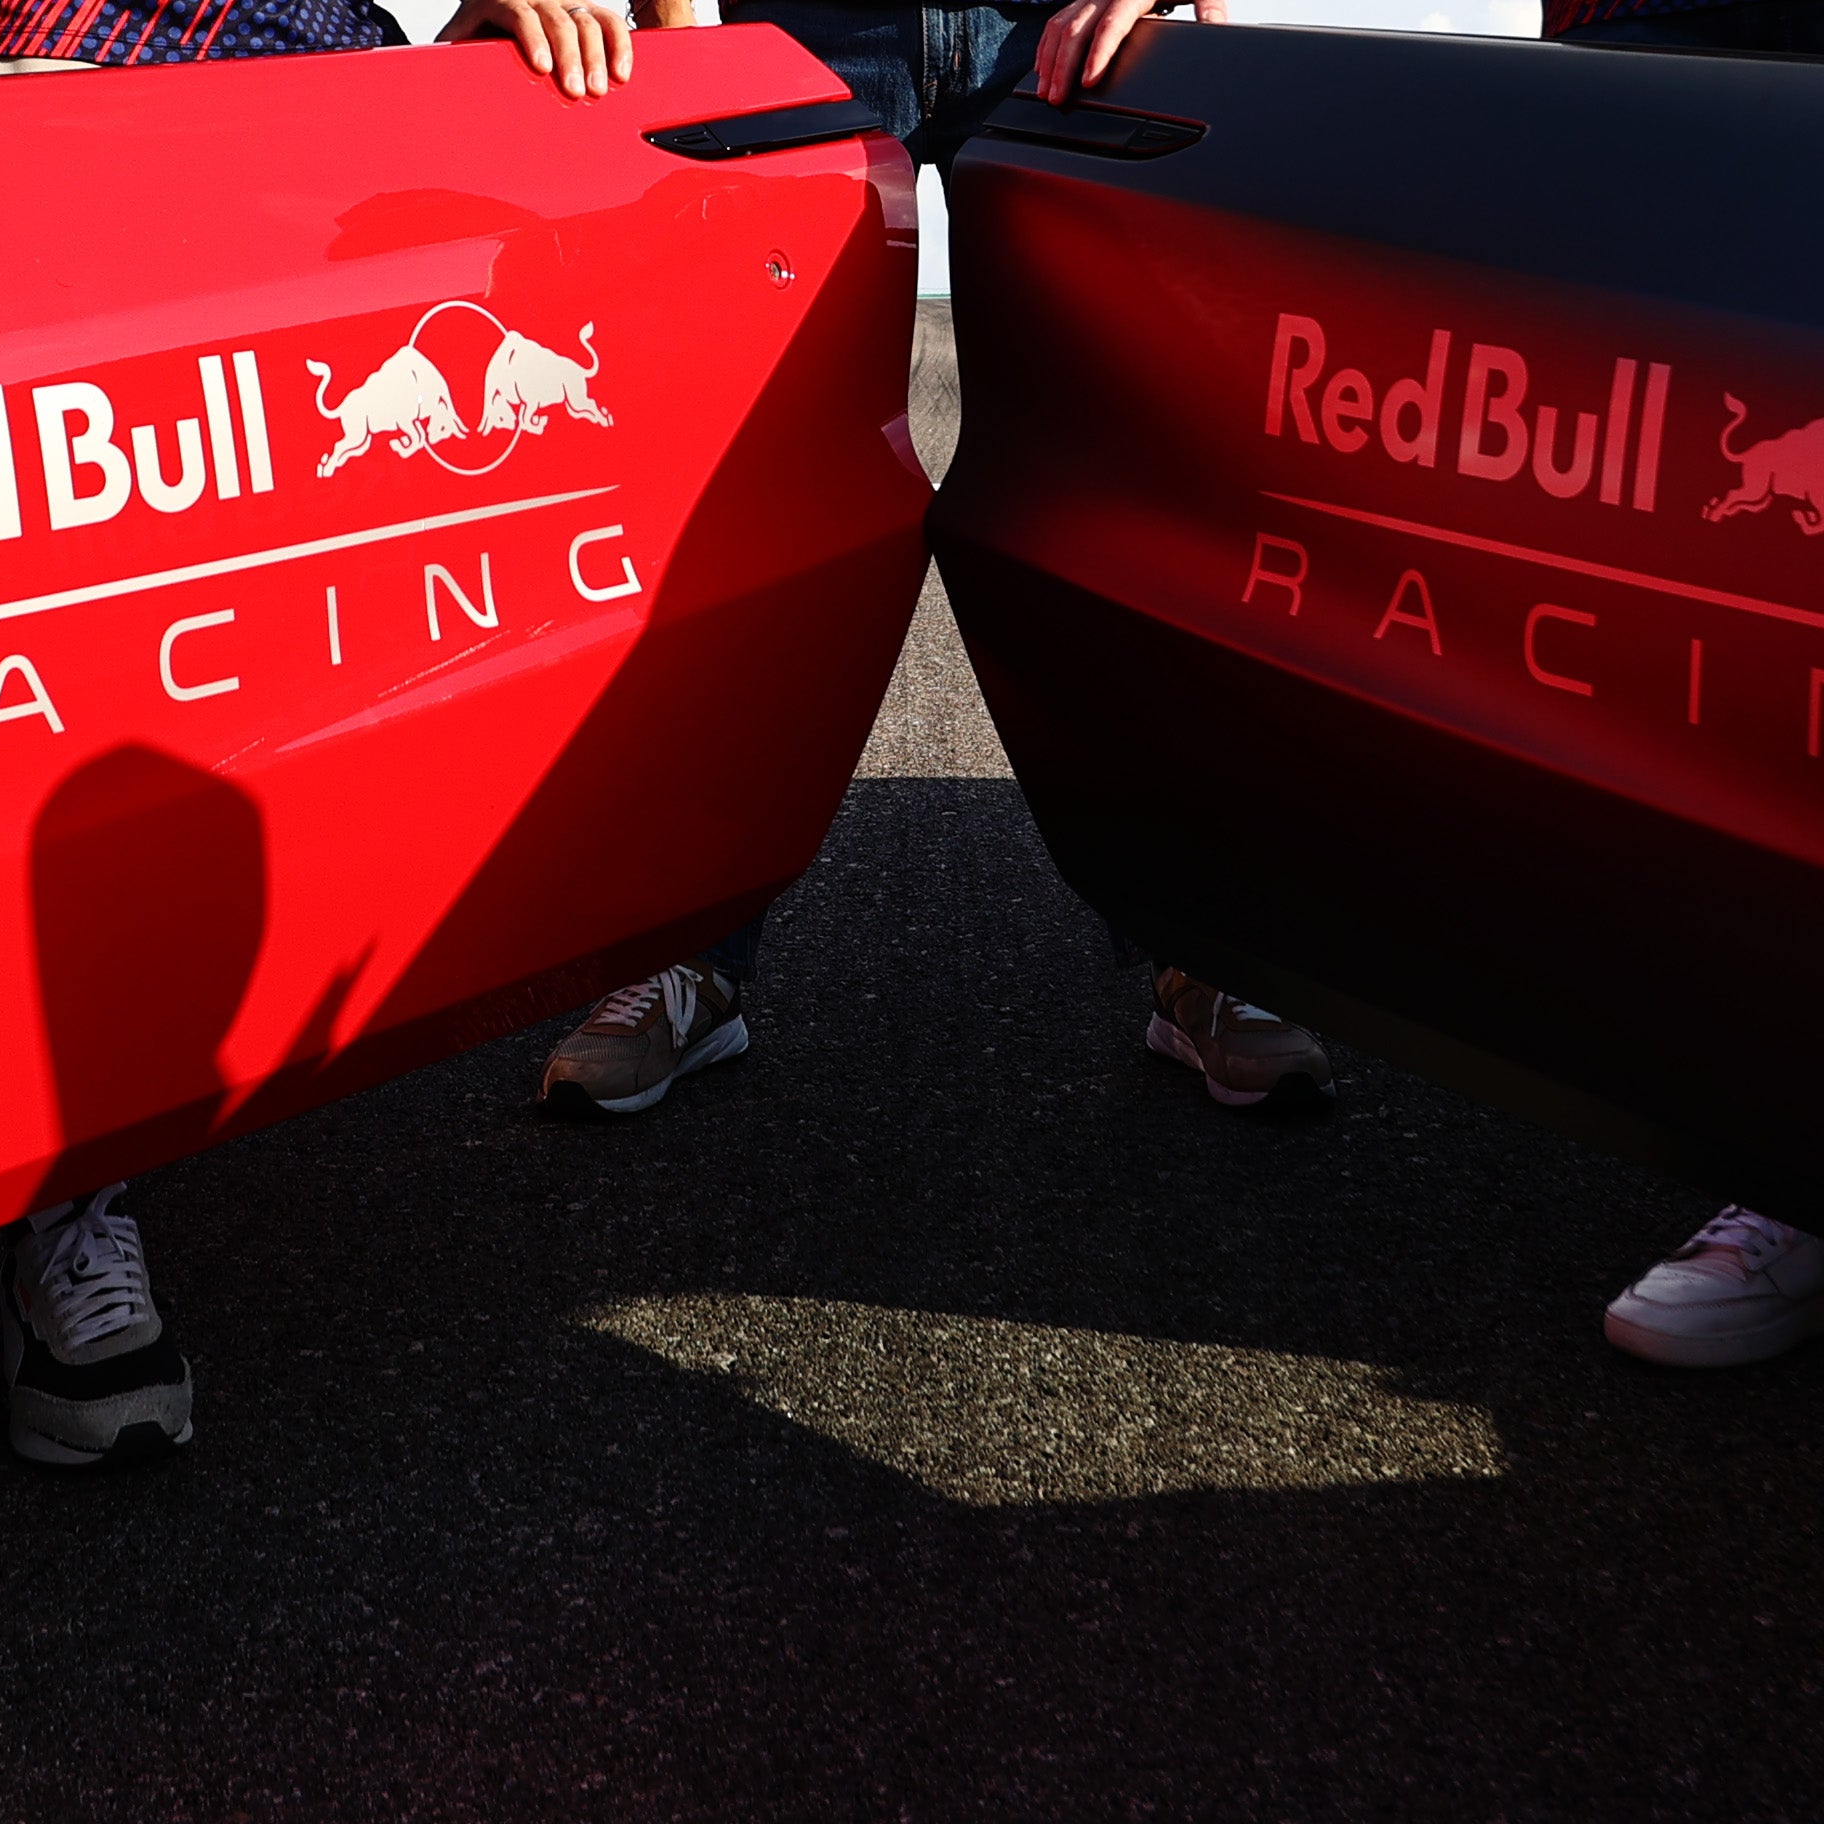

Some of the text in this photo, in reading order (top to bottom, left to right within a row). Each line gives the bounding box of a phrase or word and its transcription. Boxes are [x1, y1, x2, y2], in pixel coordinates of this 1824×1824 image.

[31, 349, 275, 531] Bull
[1264, 312, 1672, 514] Red Bull
